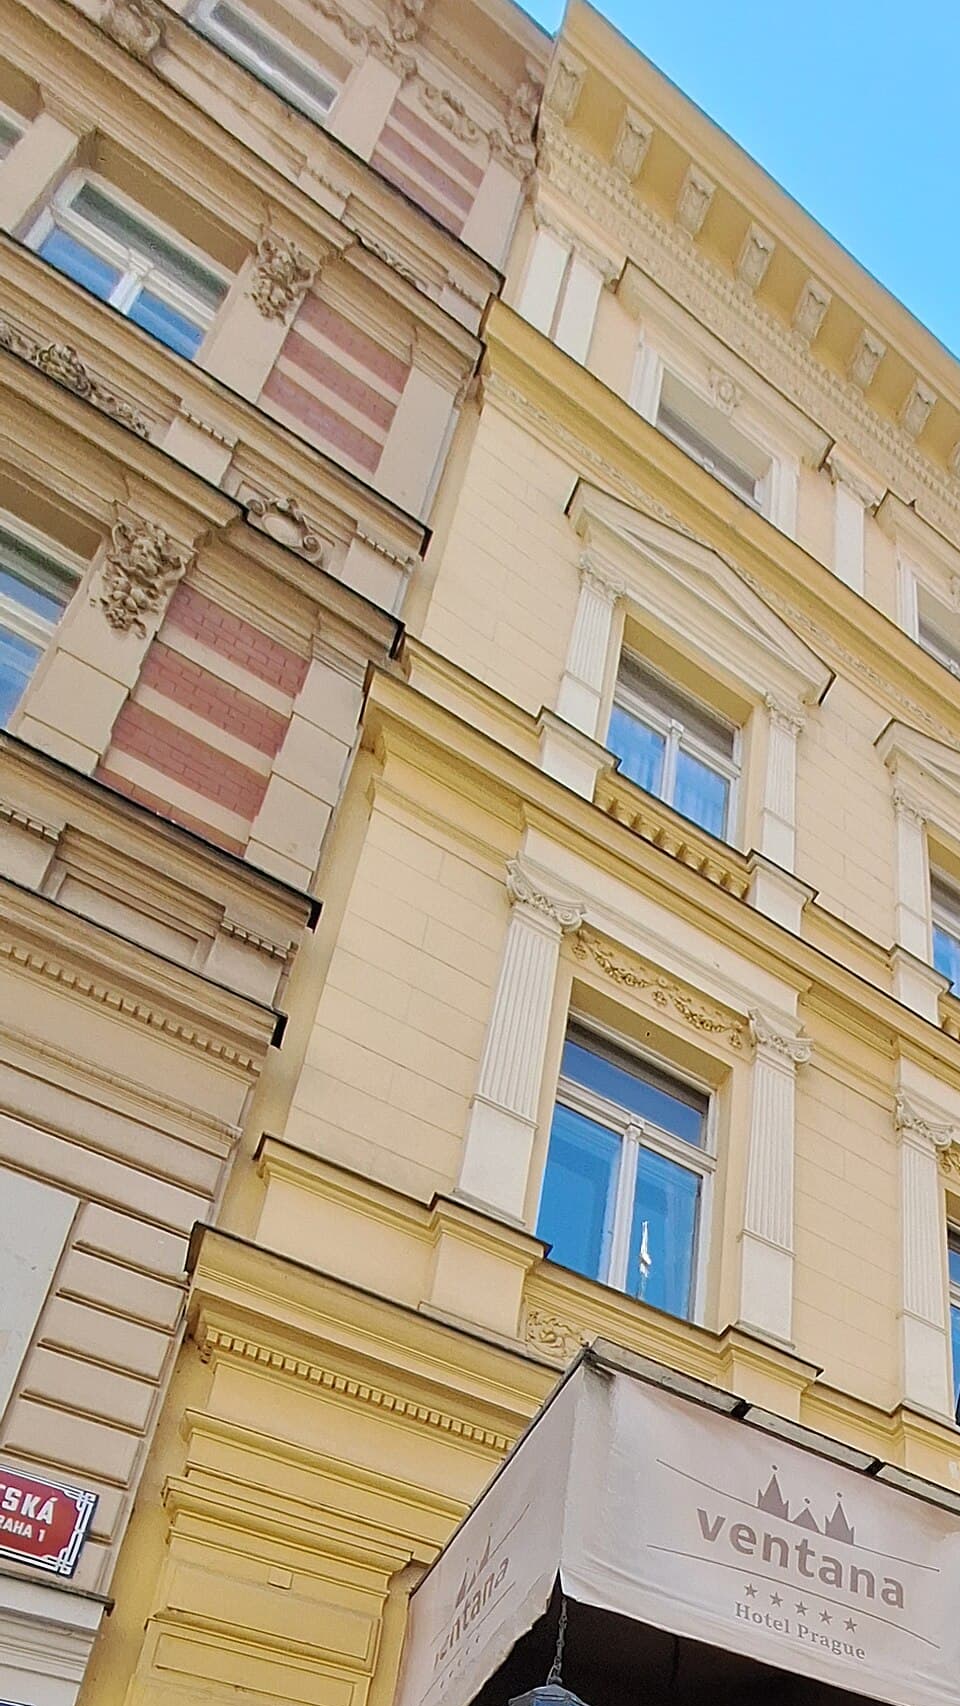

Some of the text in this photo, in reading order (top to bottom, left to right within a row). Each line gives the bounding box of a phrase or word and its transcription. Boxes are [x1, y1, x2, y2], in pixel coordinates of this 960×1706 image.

[38, 1529, 46, 1542] 1
[696, 1508, 904, 1609] ventana
[734, 1602, 866, 1660] Hotel Prague
